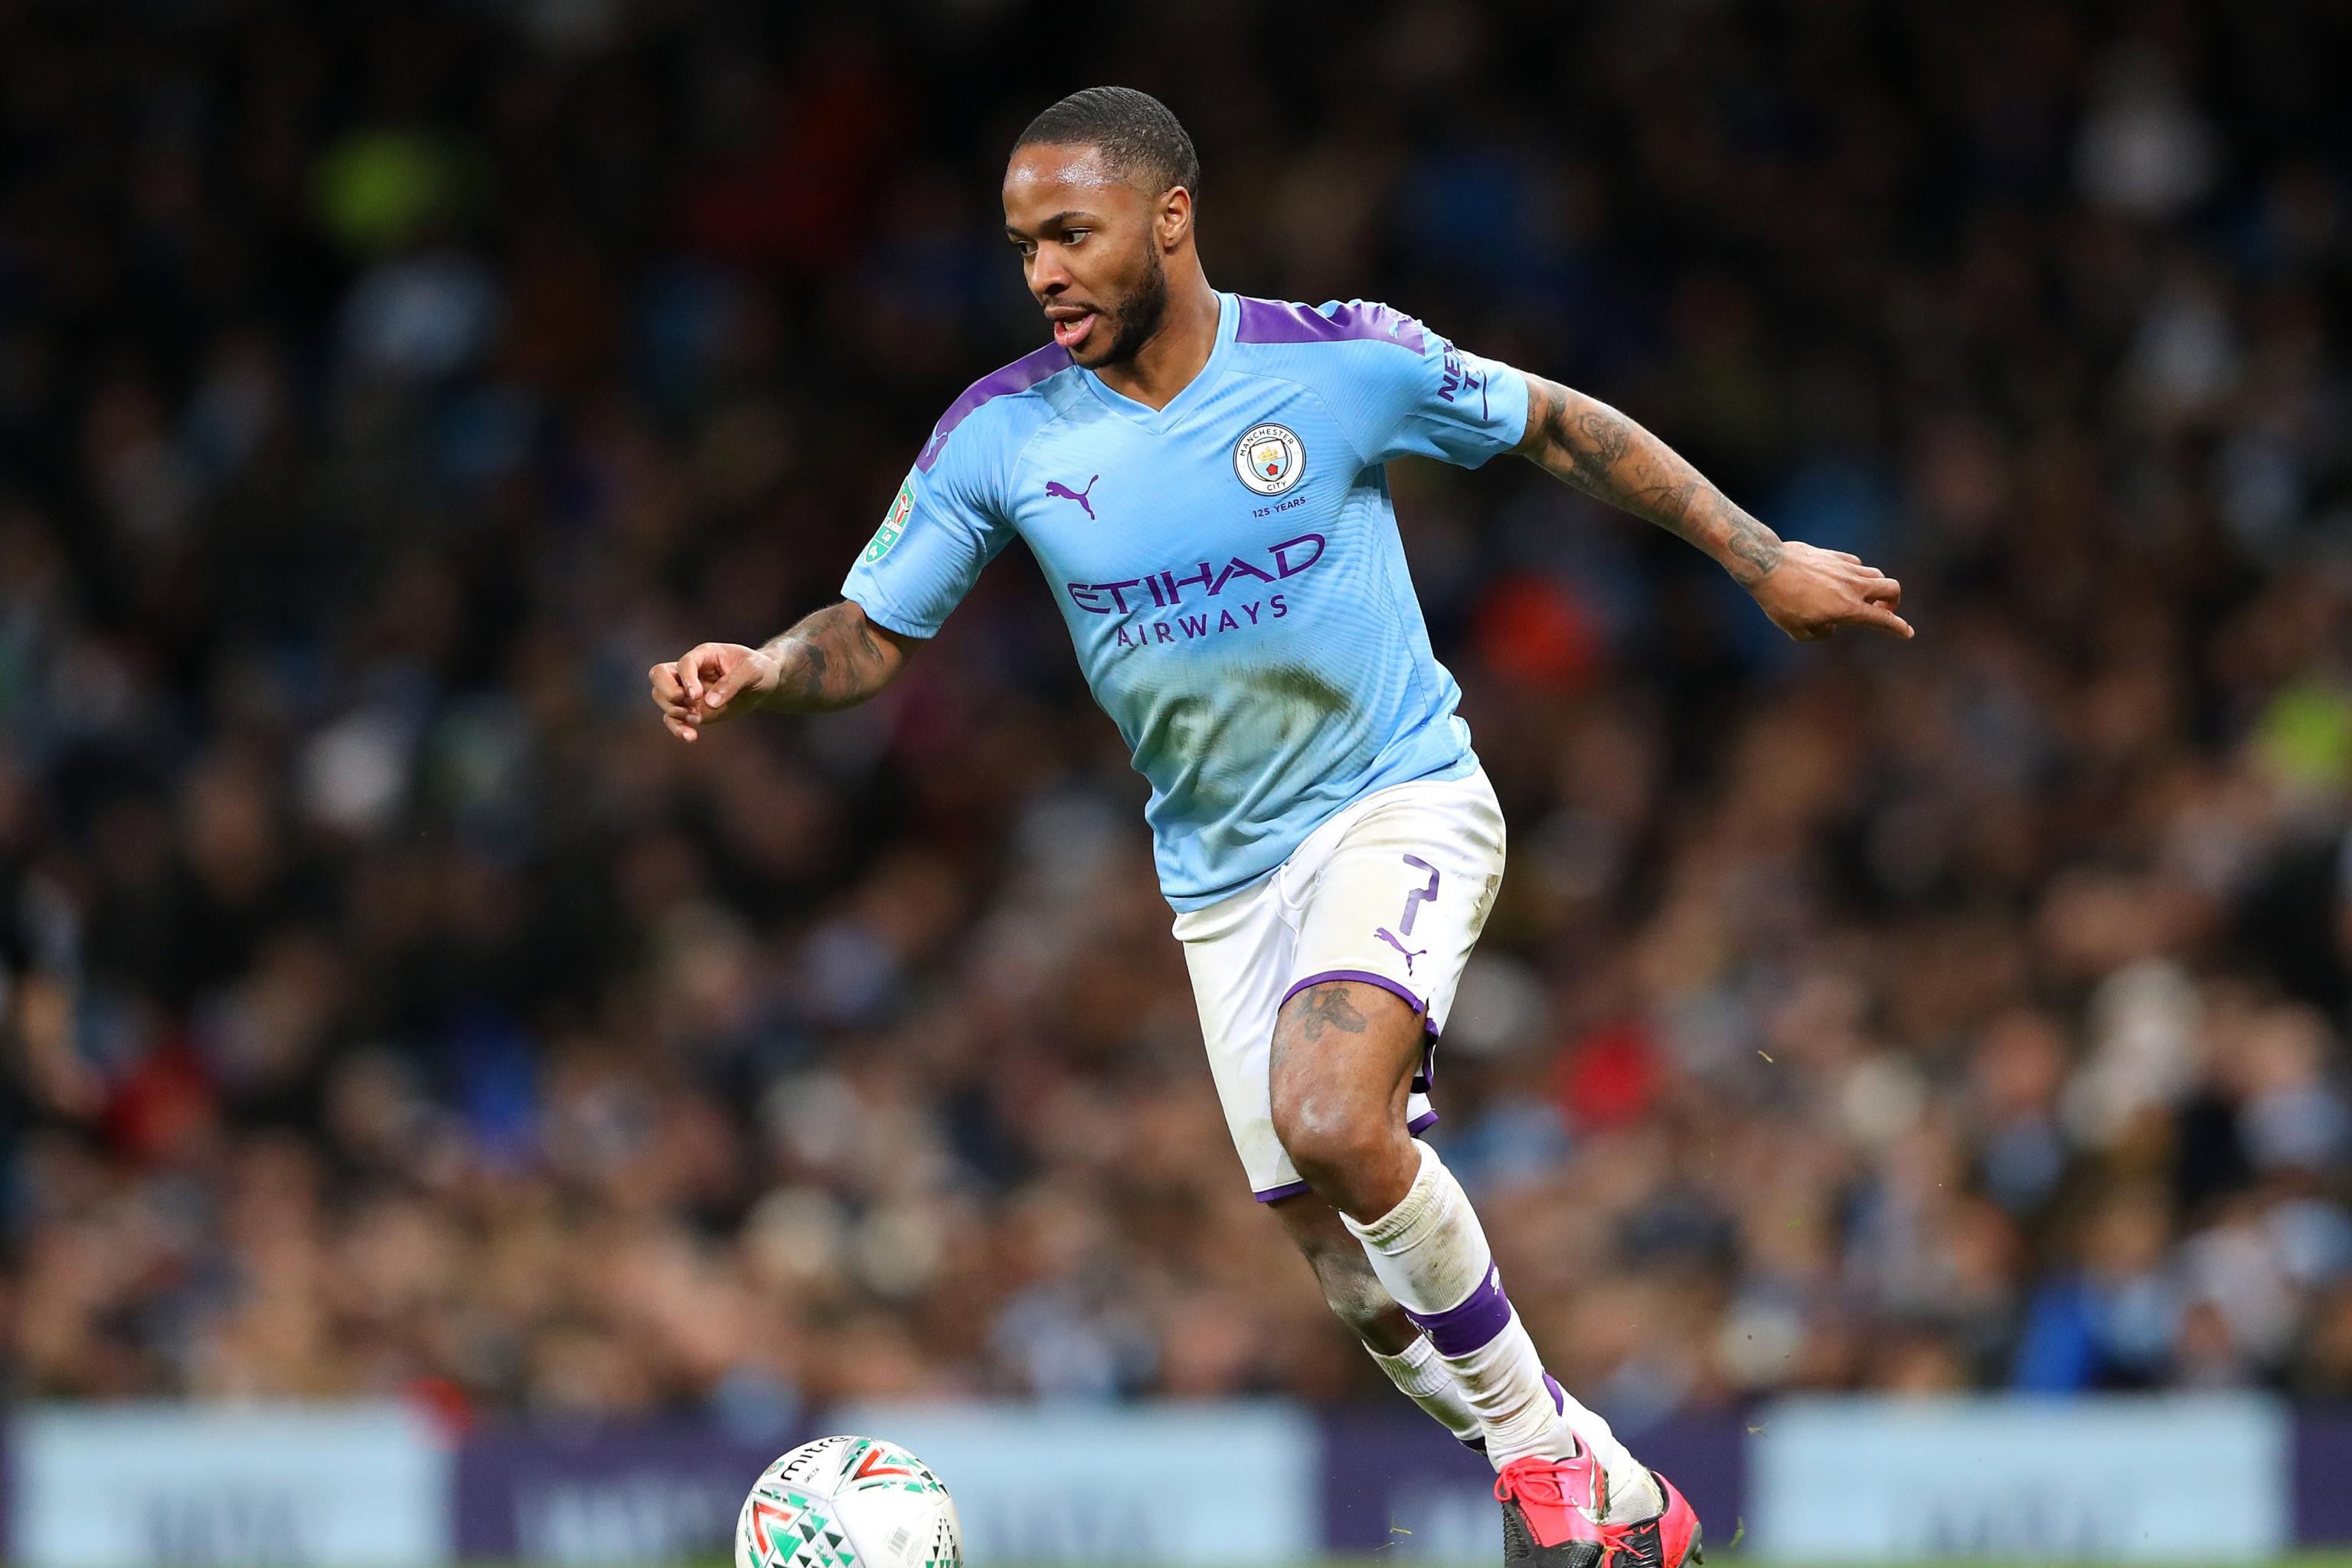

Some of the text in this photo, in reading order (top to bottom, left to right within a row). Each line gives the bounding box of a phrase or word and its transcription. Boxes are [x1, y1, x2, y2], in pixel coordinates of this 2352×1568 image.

[1240, 428, 1294, 456] MANCHESTER
[1267, 482, 1286, 491] CITY
[1253, 496, 1305, 518] 125 YEARS
[1067, 533, 1326, 614] ETIHAD
[1116, 594, 1288, 647] AIRWAYS
[1399, 853, 1440, 936] 7
